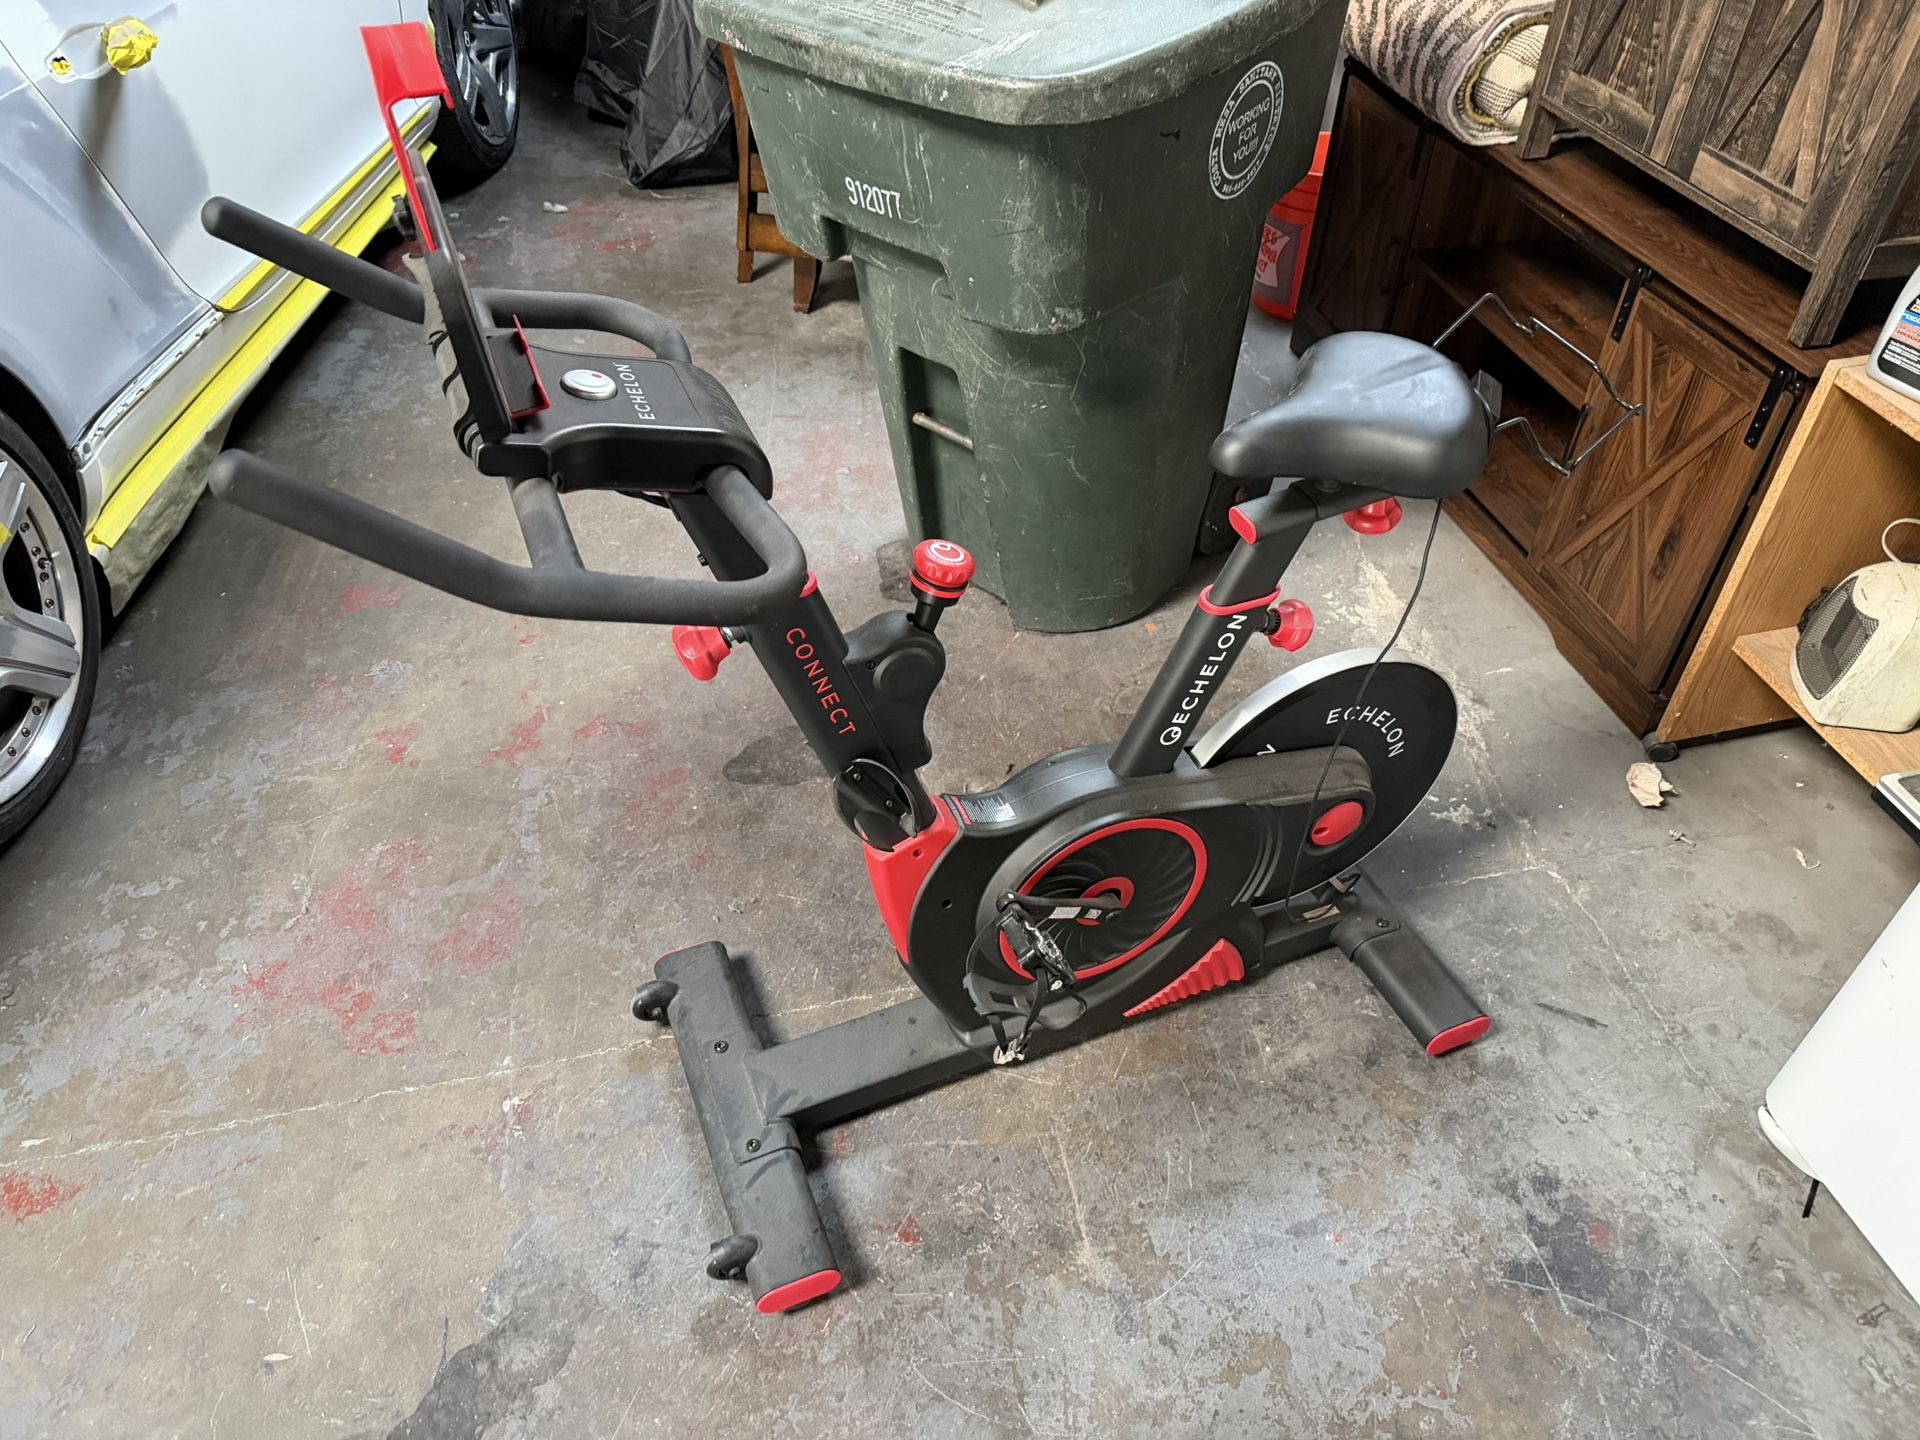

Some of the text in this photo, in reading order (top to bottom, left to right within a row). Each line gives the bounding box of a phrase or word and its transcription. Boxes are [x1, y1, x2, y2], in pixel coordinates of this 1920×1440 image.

[1239, 66, 1278, 95] SANITARY
[1215, 100, 1235, 138] MESA
[1228, 97, 1271, 136] WORKING
[1239, 122, 1258, 146] FOR
[1211, 146, 1222, 187] COSTA
[844, 176, 902, 220] 912077
[613, 362, 656, 420] ECHELON
[786, 627, 857, 735] CONNECT
[1325, 705, 1406, 758] ECHELON
